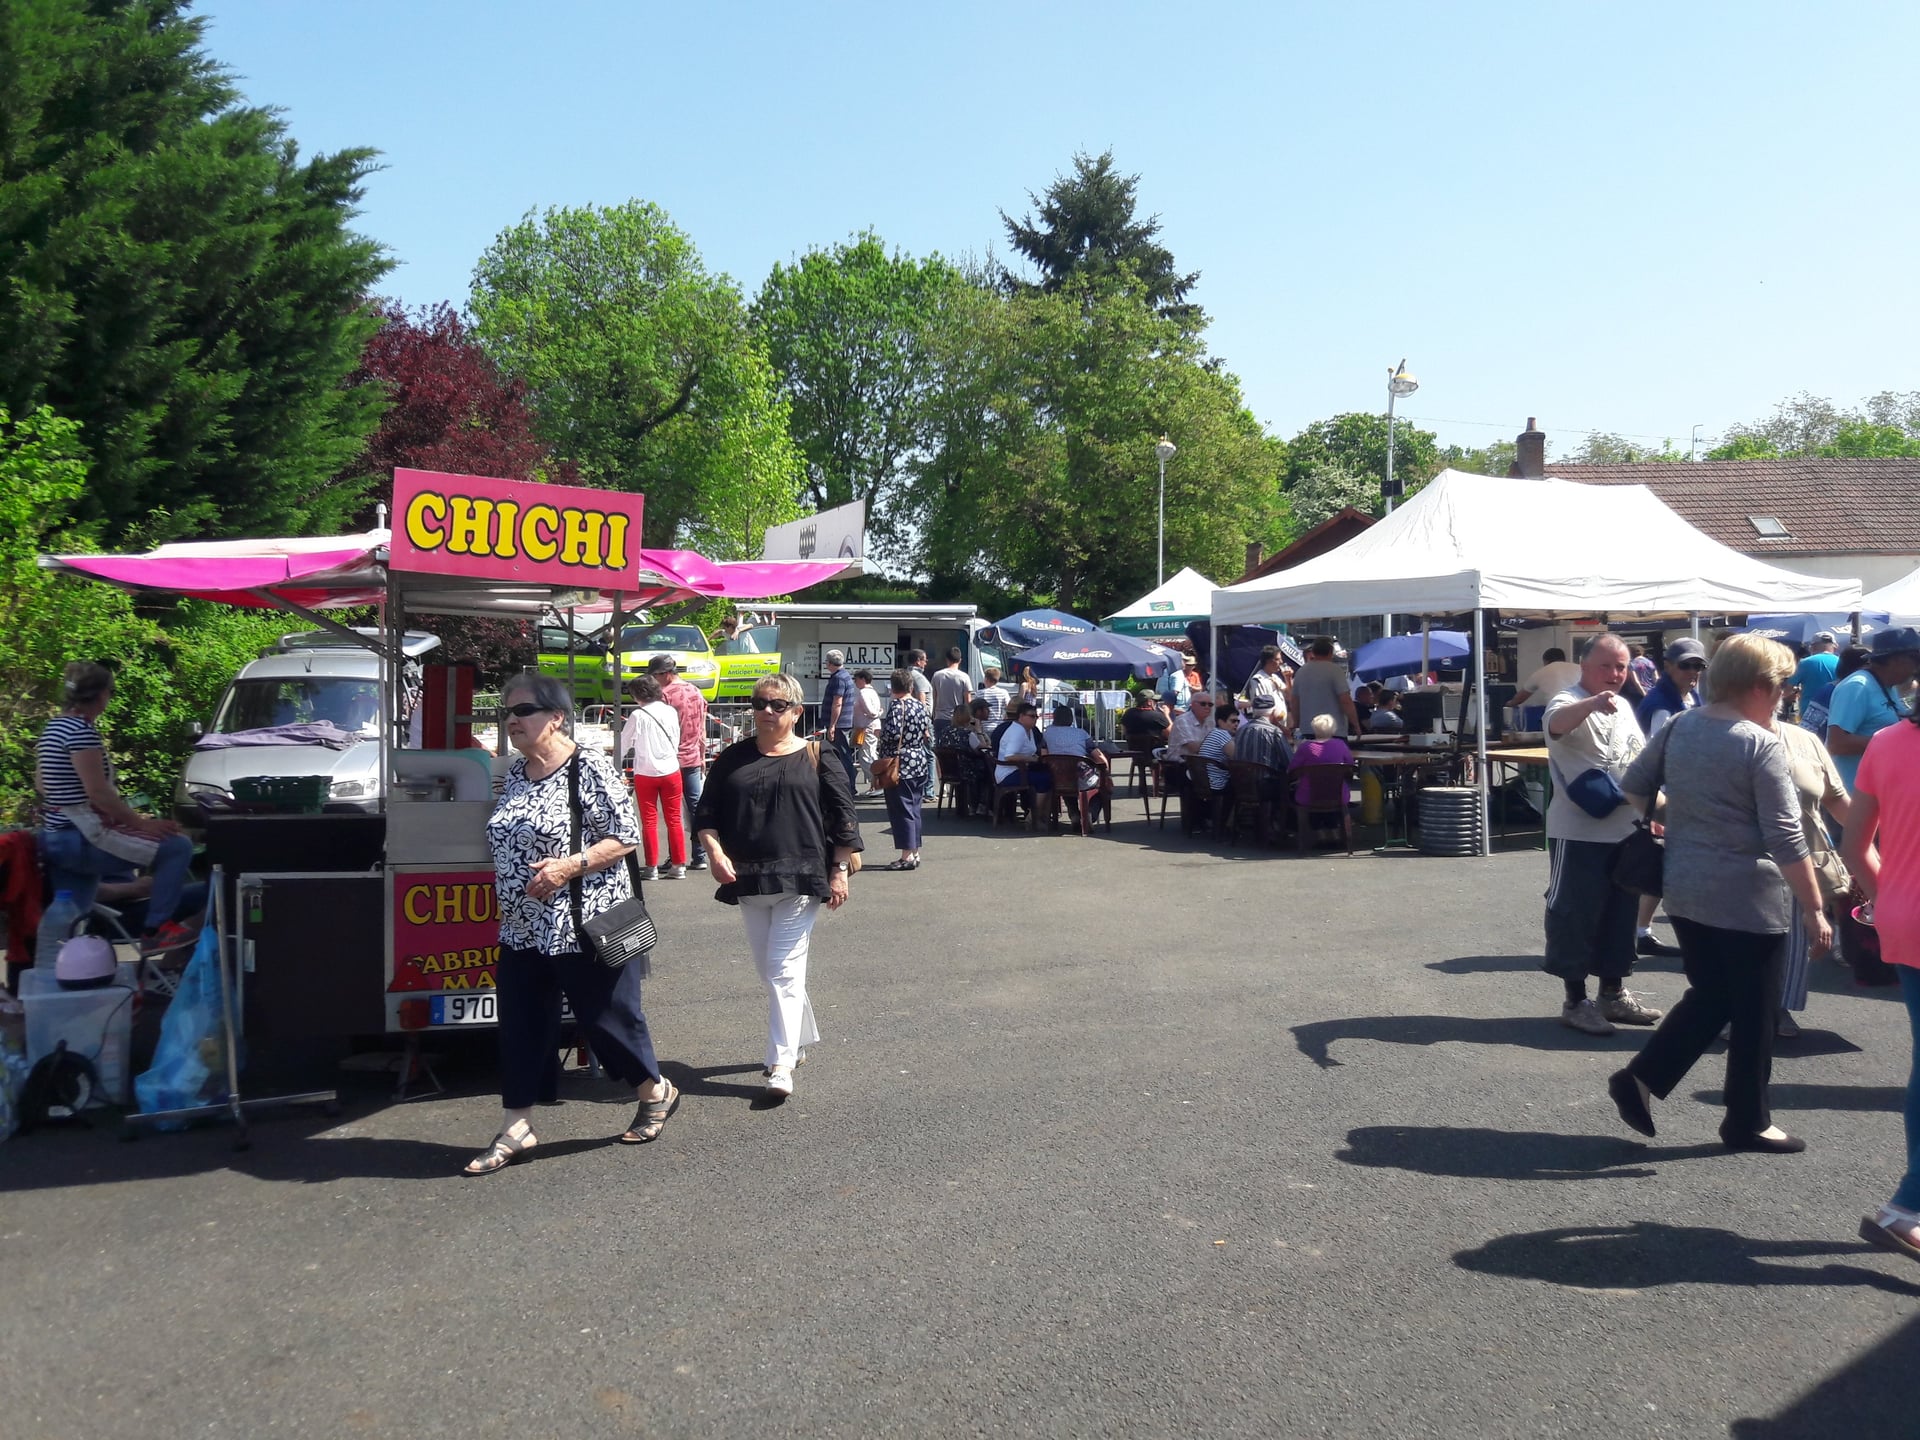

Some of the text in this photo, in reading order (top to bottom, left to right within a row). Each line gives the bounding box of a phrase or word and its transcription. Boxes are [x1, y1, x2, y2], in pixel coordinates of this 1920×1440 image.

[406, 490, 630, 570] CHICHI
[1152, 621, 1180, 629] VRAIE
[403, 884, 500, 925] CHU
[442, 971, 496, 991] MA
[452, 997, 494, 1020] 970
